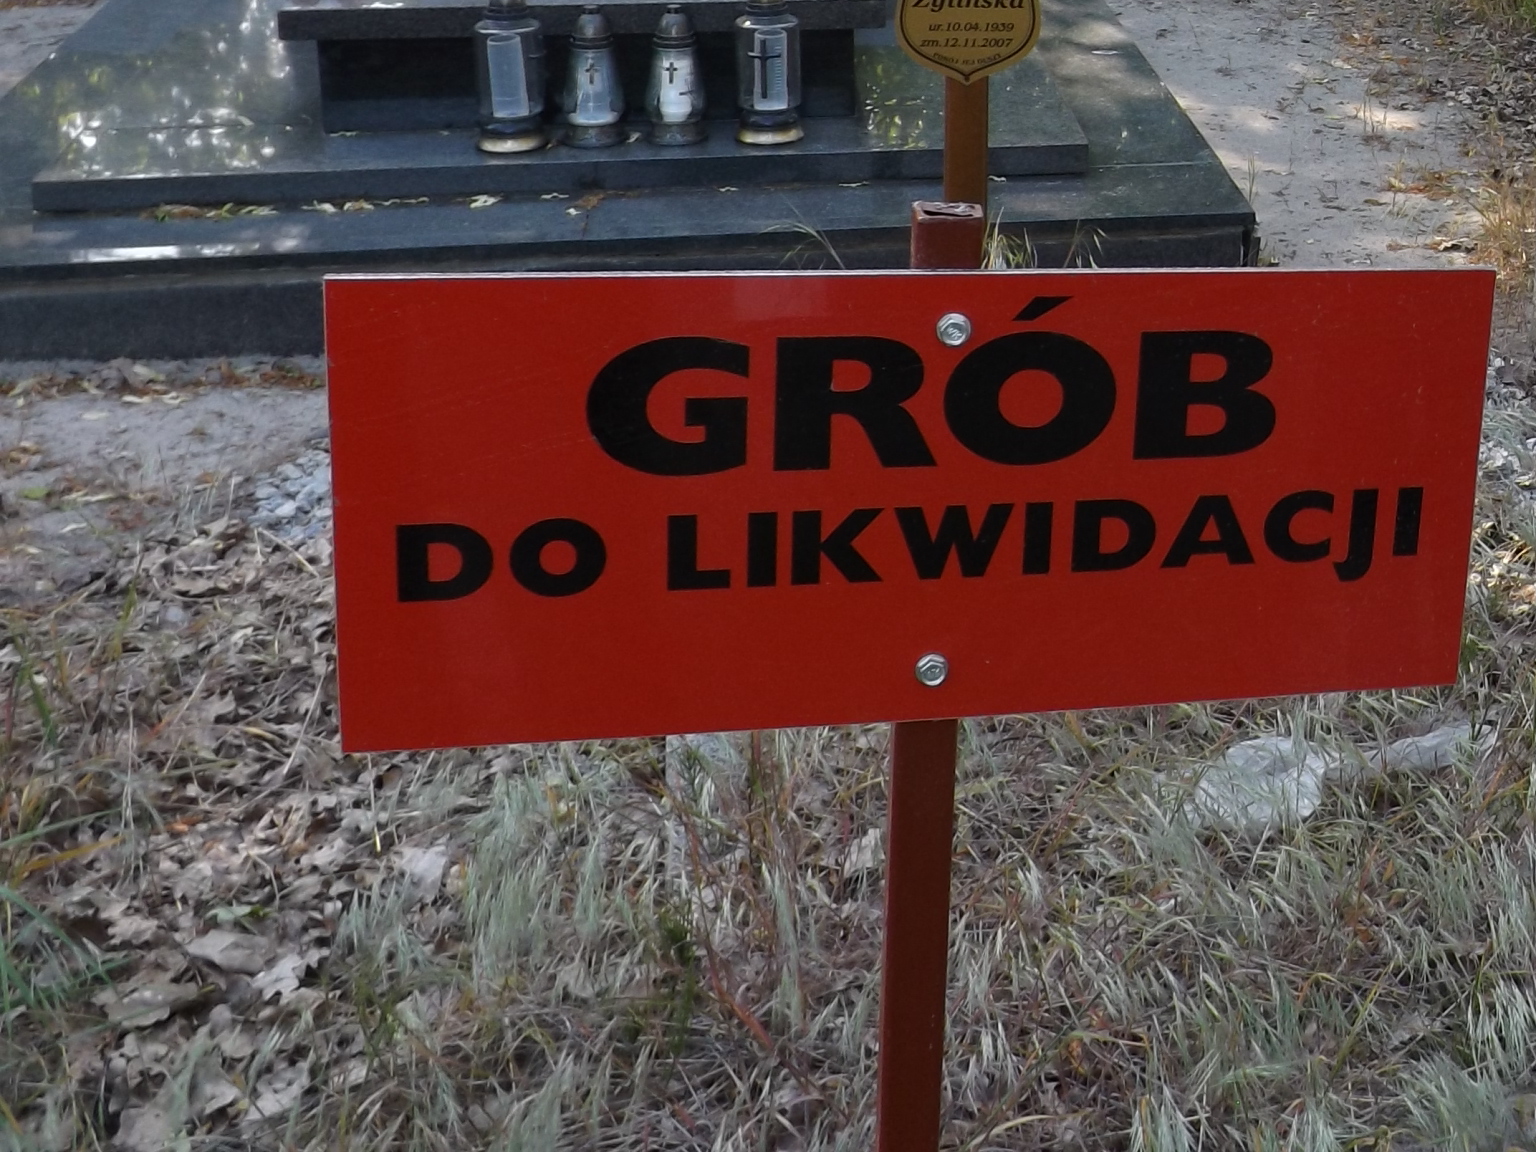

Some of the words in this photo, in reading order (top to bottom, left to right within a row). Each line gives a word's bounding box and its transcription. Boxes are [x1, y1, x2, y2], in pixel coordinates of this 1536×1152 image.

[584, 295, 1279, 478] GRÓB
[395, 516, 608, 604] DO
[666, 484, 1425, 594] LIKWIDACJI
